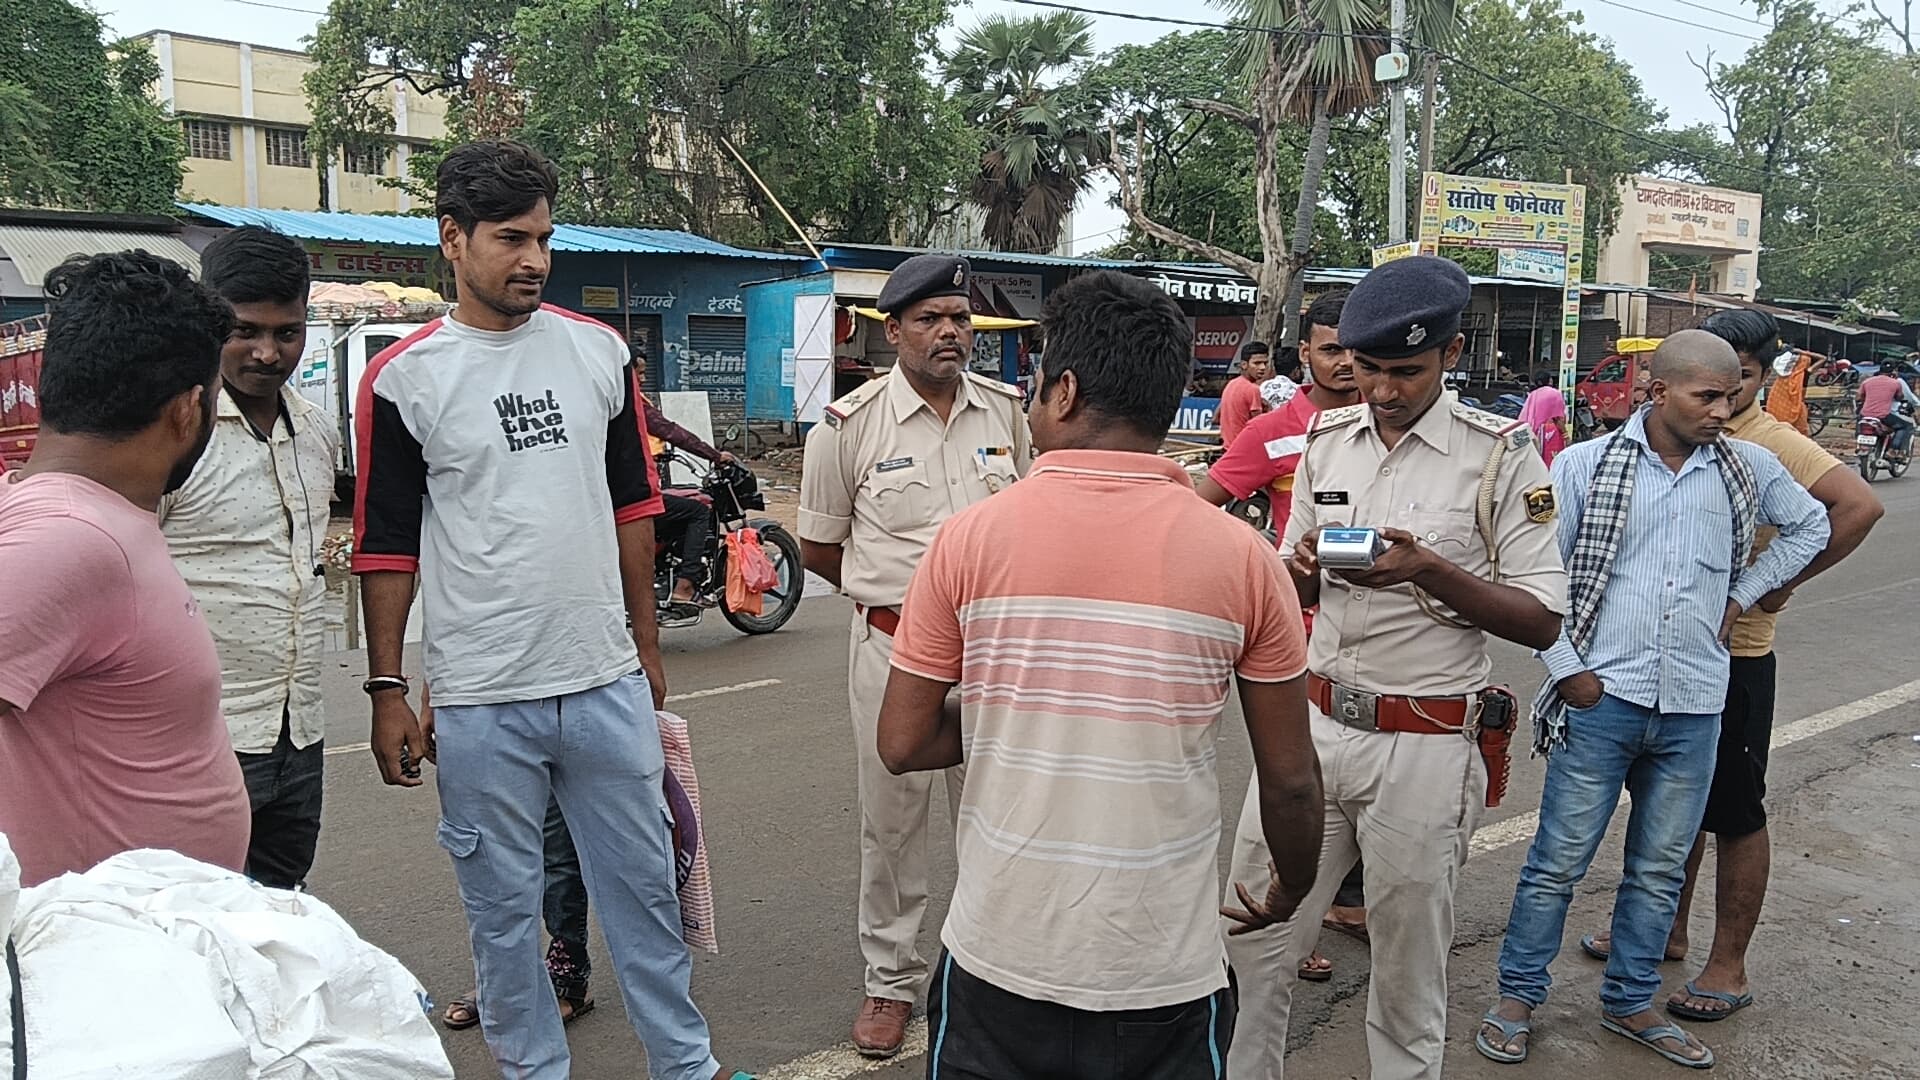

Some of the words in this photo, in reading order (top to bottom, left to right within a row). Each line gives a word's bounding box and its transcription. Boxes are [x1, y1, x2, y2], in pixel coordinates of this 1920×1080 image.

[1446, 185, 1498, 210] संतोष
[1503, 191, 1566, 215] फोनेक्स
[334, 251, 427, 273] टाईल्स
[1189, 281, 1214, 300] पर
[1216, 280, 1257, 304] फोन
[1196, 331, 1240, 346] SERVO
[677, 350, 689, 392] almia
[688, 351, 746, 372] Dalmi
[493, 389, 560, 418] What
[500, 412, 563, 434] the
[505, 427, 569, 452] heck
